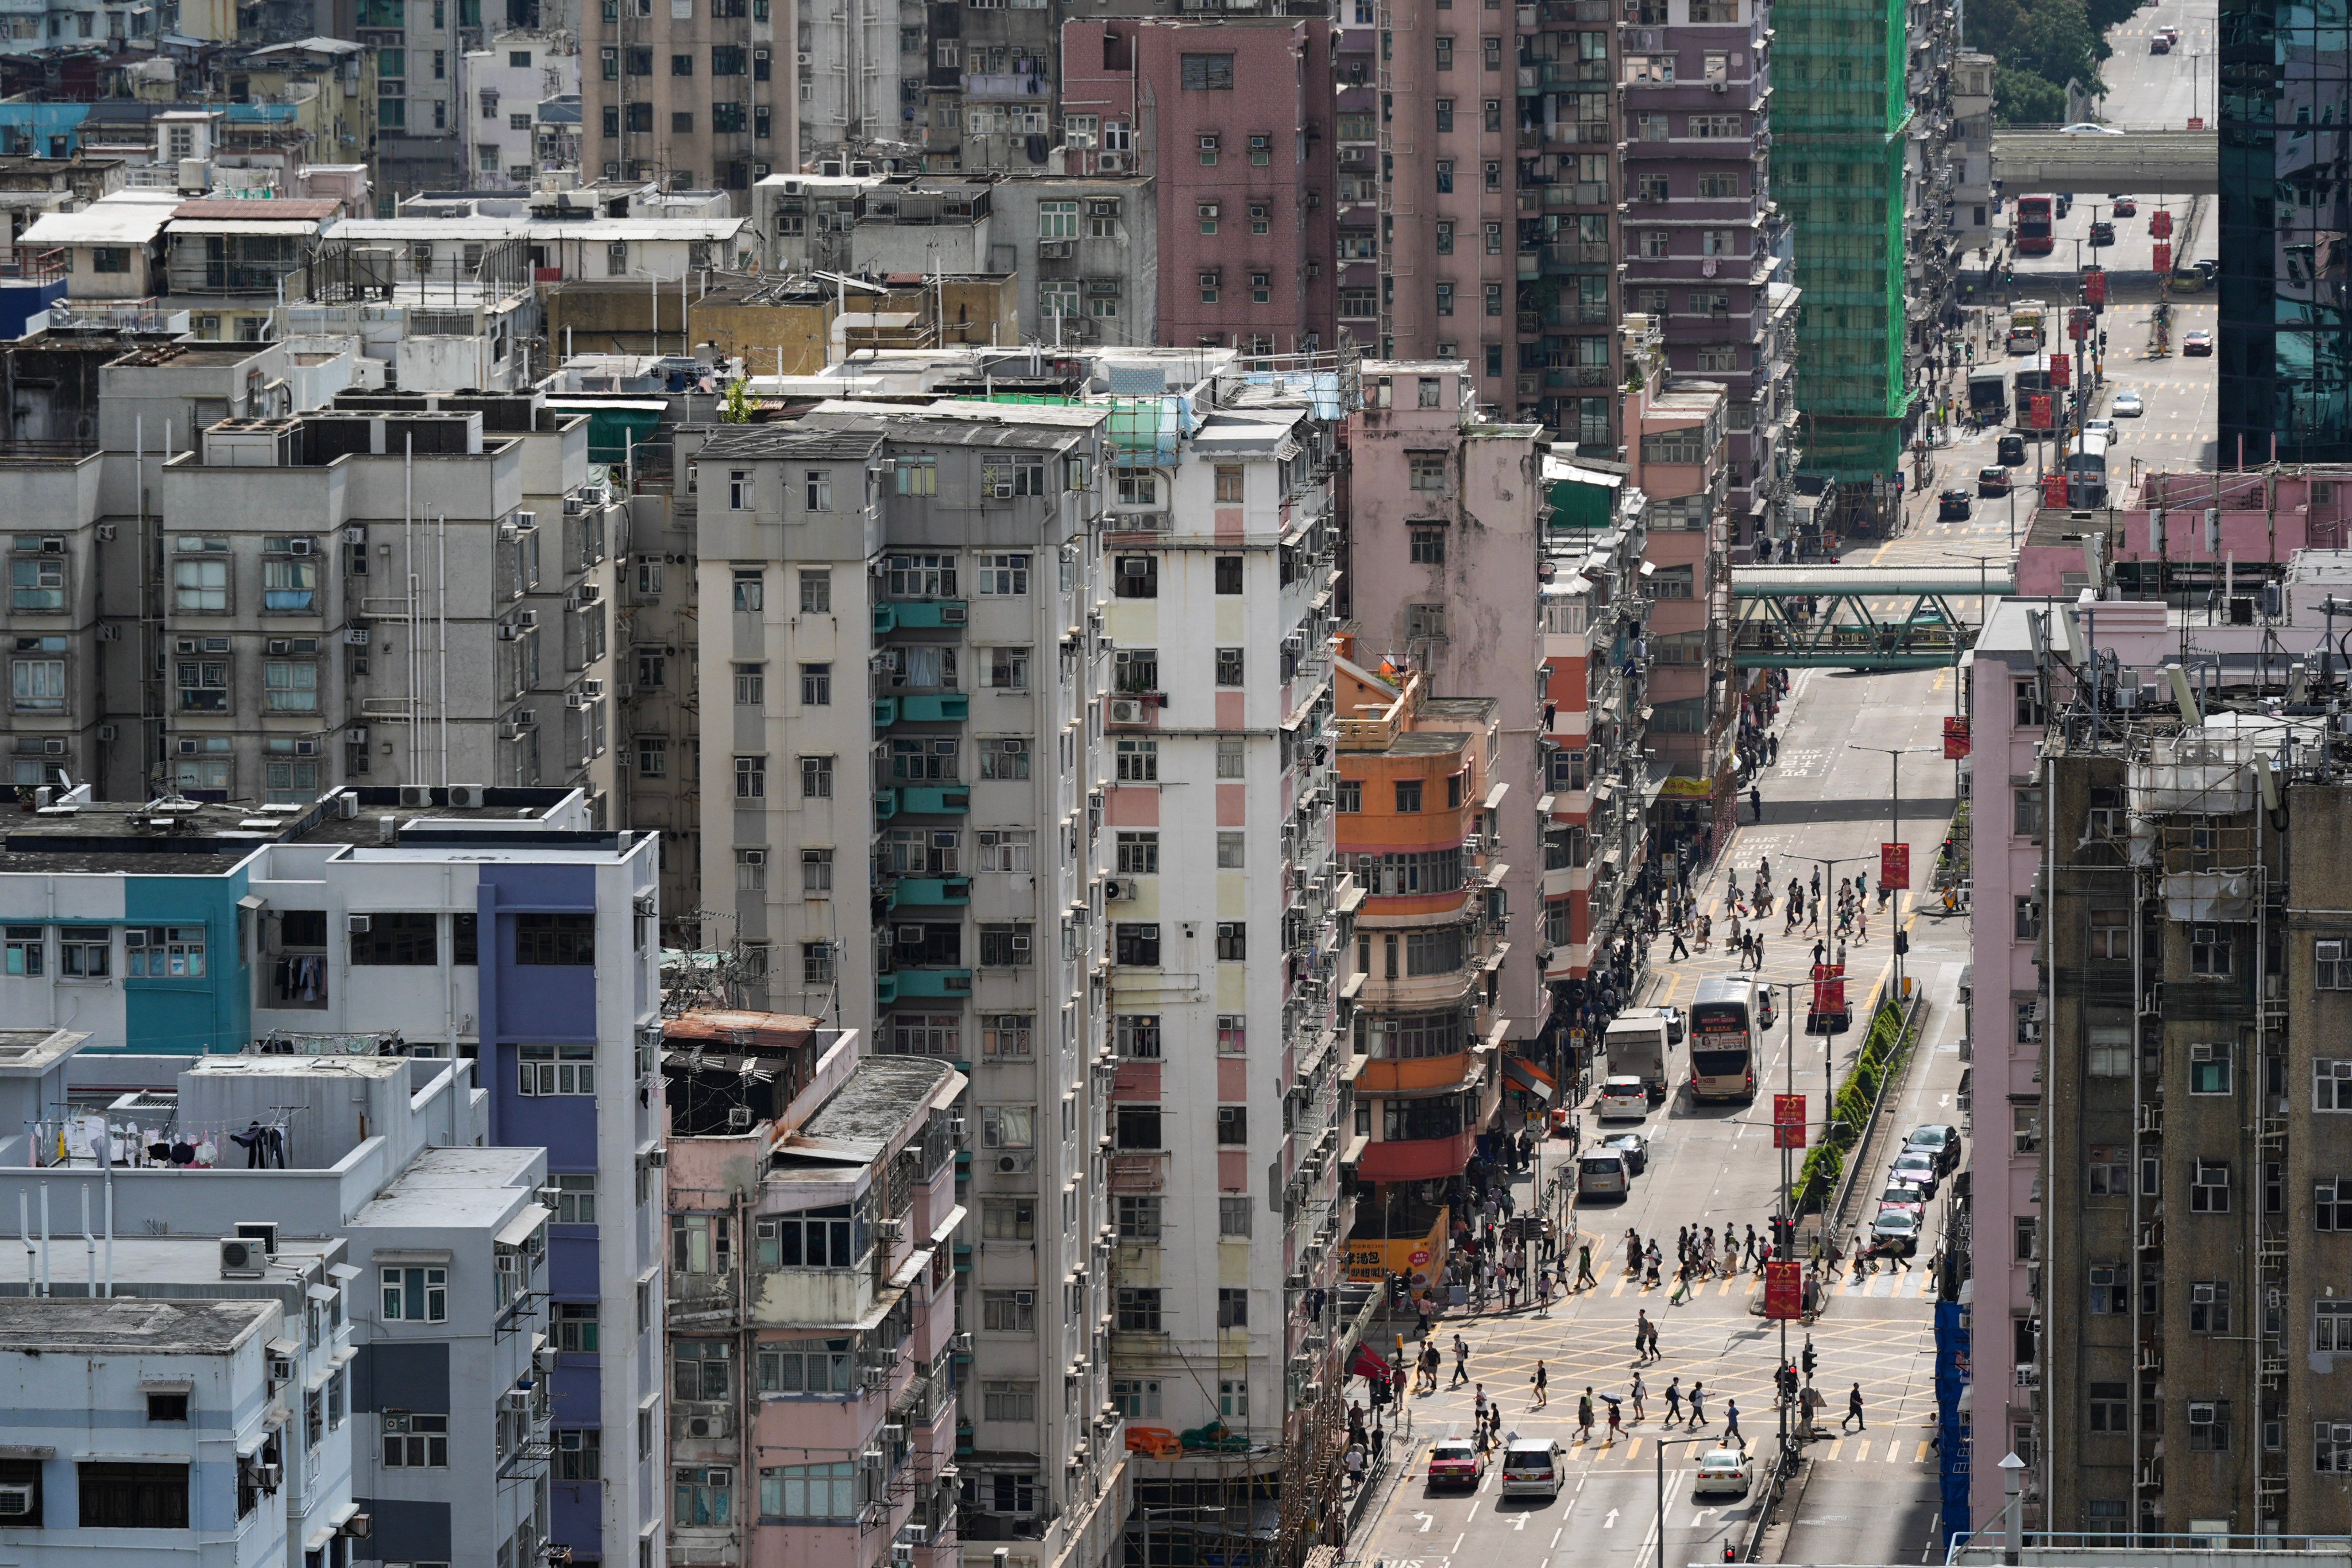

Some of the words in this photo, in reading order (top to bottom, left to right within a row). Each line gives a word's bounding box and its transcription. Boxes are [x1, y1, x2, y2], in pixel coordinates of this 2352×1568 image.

[2051, 477, 2061, 486] 75
[1779, 760, 1816, 768] 巴士
[1888, 845, 1902, 857] 75
[1822, 966, 1837, 979] 75
[1782, 1097, 1798, 1111] 75
[1775, 1264, 1792, 1279] 75
